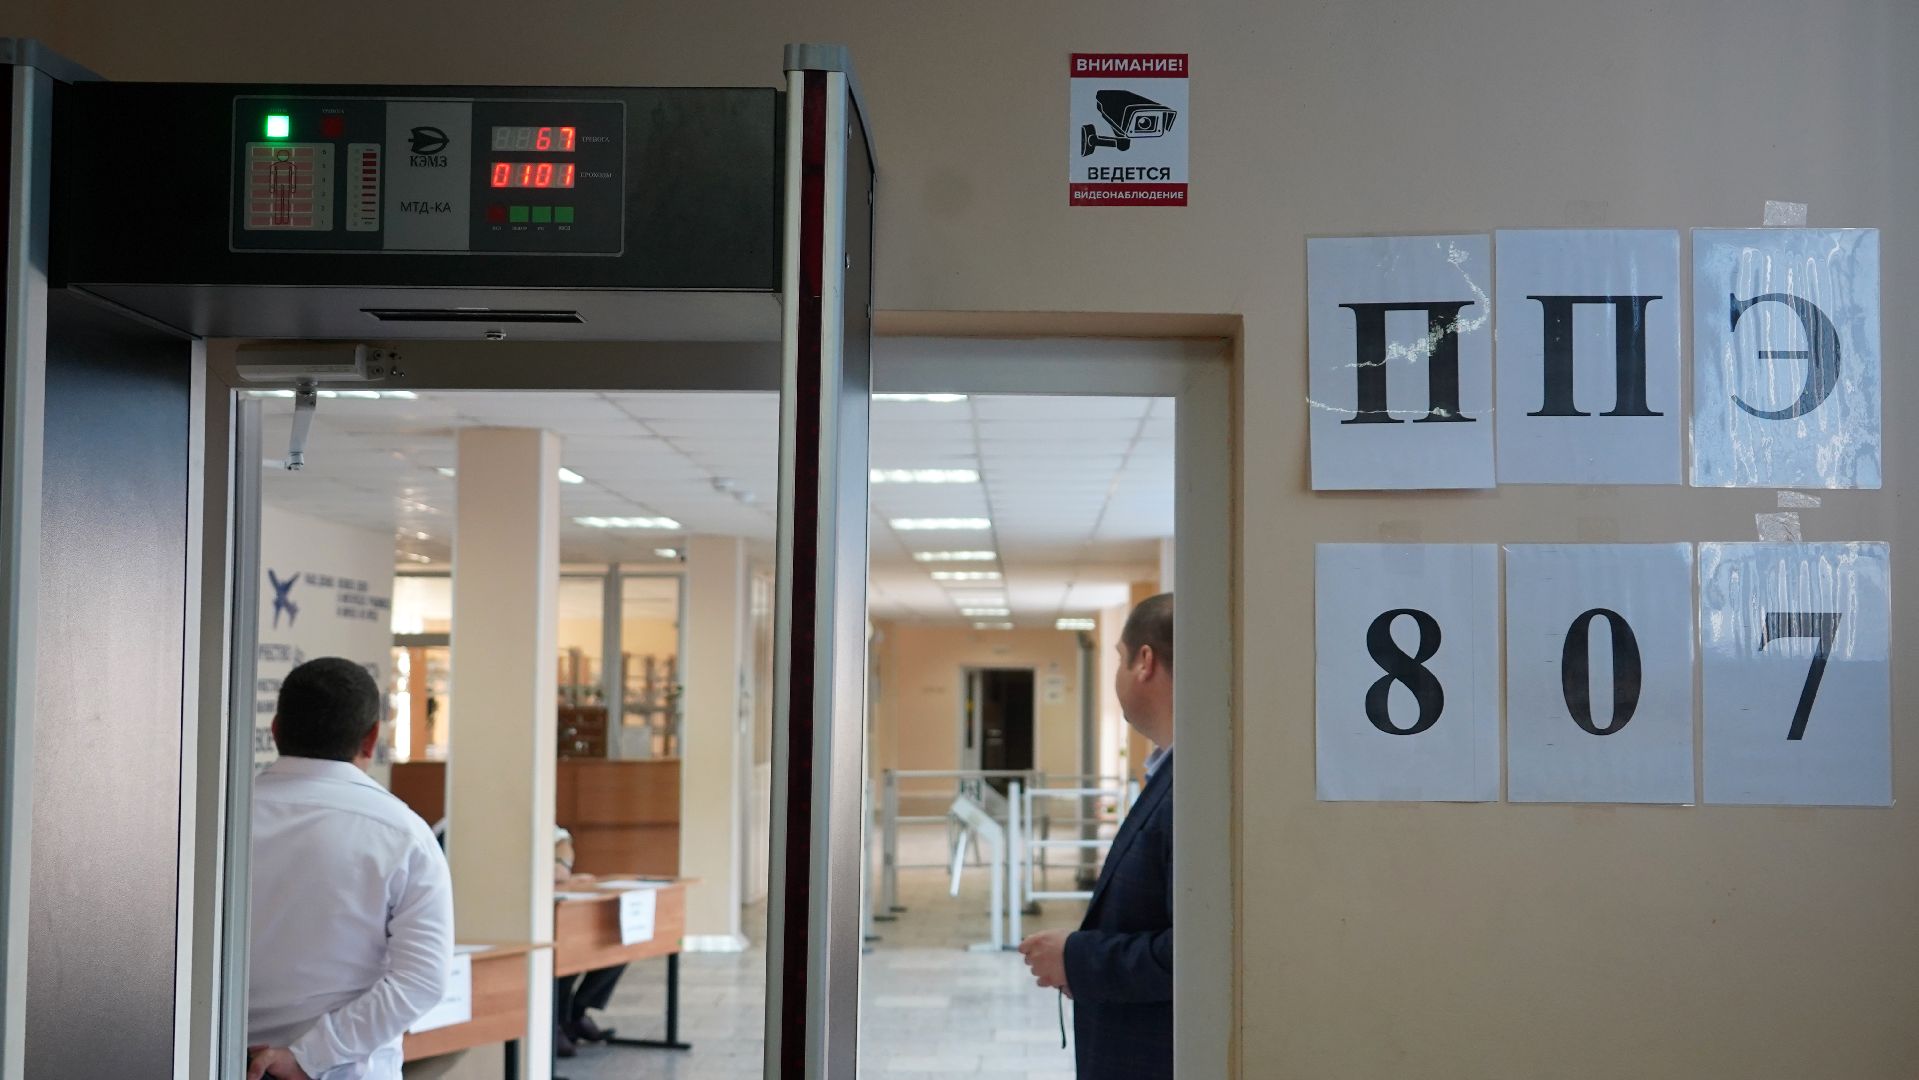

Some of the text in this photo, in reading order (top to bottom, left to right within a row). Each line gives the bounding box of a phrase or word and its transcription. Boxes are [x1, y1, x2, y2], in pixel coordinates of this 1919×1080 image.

[1076, 58, 1183, 72] ВНИМАНИЕ!
[535, 127, 575, 150] 67
[409, 155, 448, 168] КЭМЗ
[493, 163, 574, 187] 0101
[1087, 166, 1171, 182] ВЕДЕТСЯ
[1074, 191, 1184, 200] ВИДЕОНАБЛЮДЕНИЕ
[400, 201, 452, 214] МТД-КА
